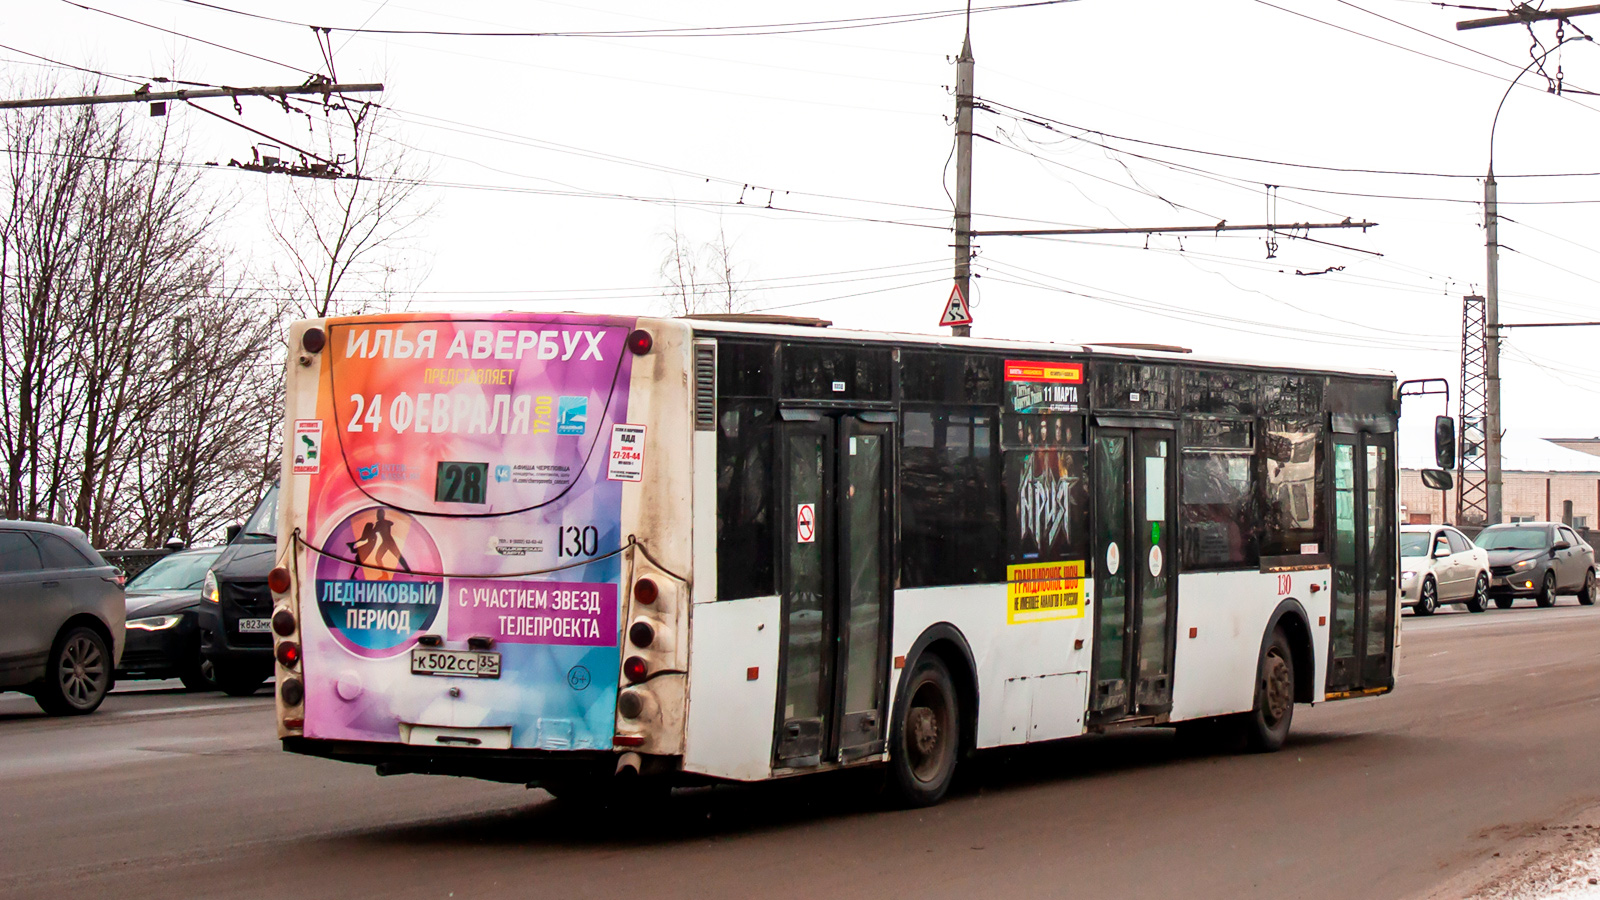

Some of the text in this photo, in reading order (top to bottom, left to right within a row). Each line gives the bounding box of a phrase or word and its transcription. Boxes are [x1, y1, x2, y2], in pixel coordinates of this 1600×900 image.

[345, 329, 607, 361] ИЛЬЯ АВЕРБУХ
[424, 368, 515, 385] ПРЕДСТАВЛЯЕТ
[1044, 386, 1052, 402] 11
[1054, 386, 1078, 402] МАРТА
[347, 391, 532, 434] 24 ФЕВРАЛЯ
[533, 395, 552, 435] 17:00
[620, 434, 636, 443] ПДД
[612, 451, 640, 460] 27-24-44
[445, 464, 482, 502] 28
[558, 525, 598, 558] 130
[1014, 565, 1078, 594] ГРАНДИОЗНОЕ ШОУ
[1278, 574, 1292, 596] 130
[322, 580, 436, 607] ЛЕДНИКОВЫЙ
[458, 588, 601, 615] С УЧАСТИЕМ ЗВЕЗД
[346, 608, 411, 635] ПЕРИОД
[498, 616, 600, 639] ТЕЛЕПРОЕКТА
[480, 656, 494, 668] 35
[570, 670, 587, 686] 6+
